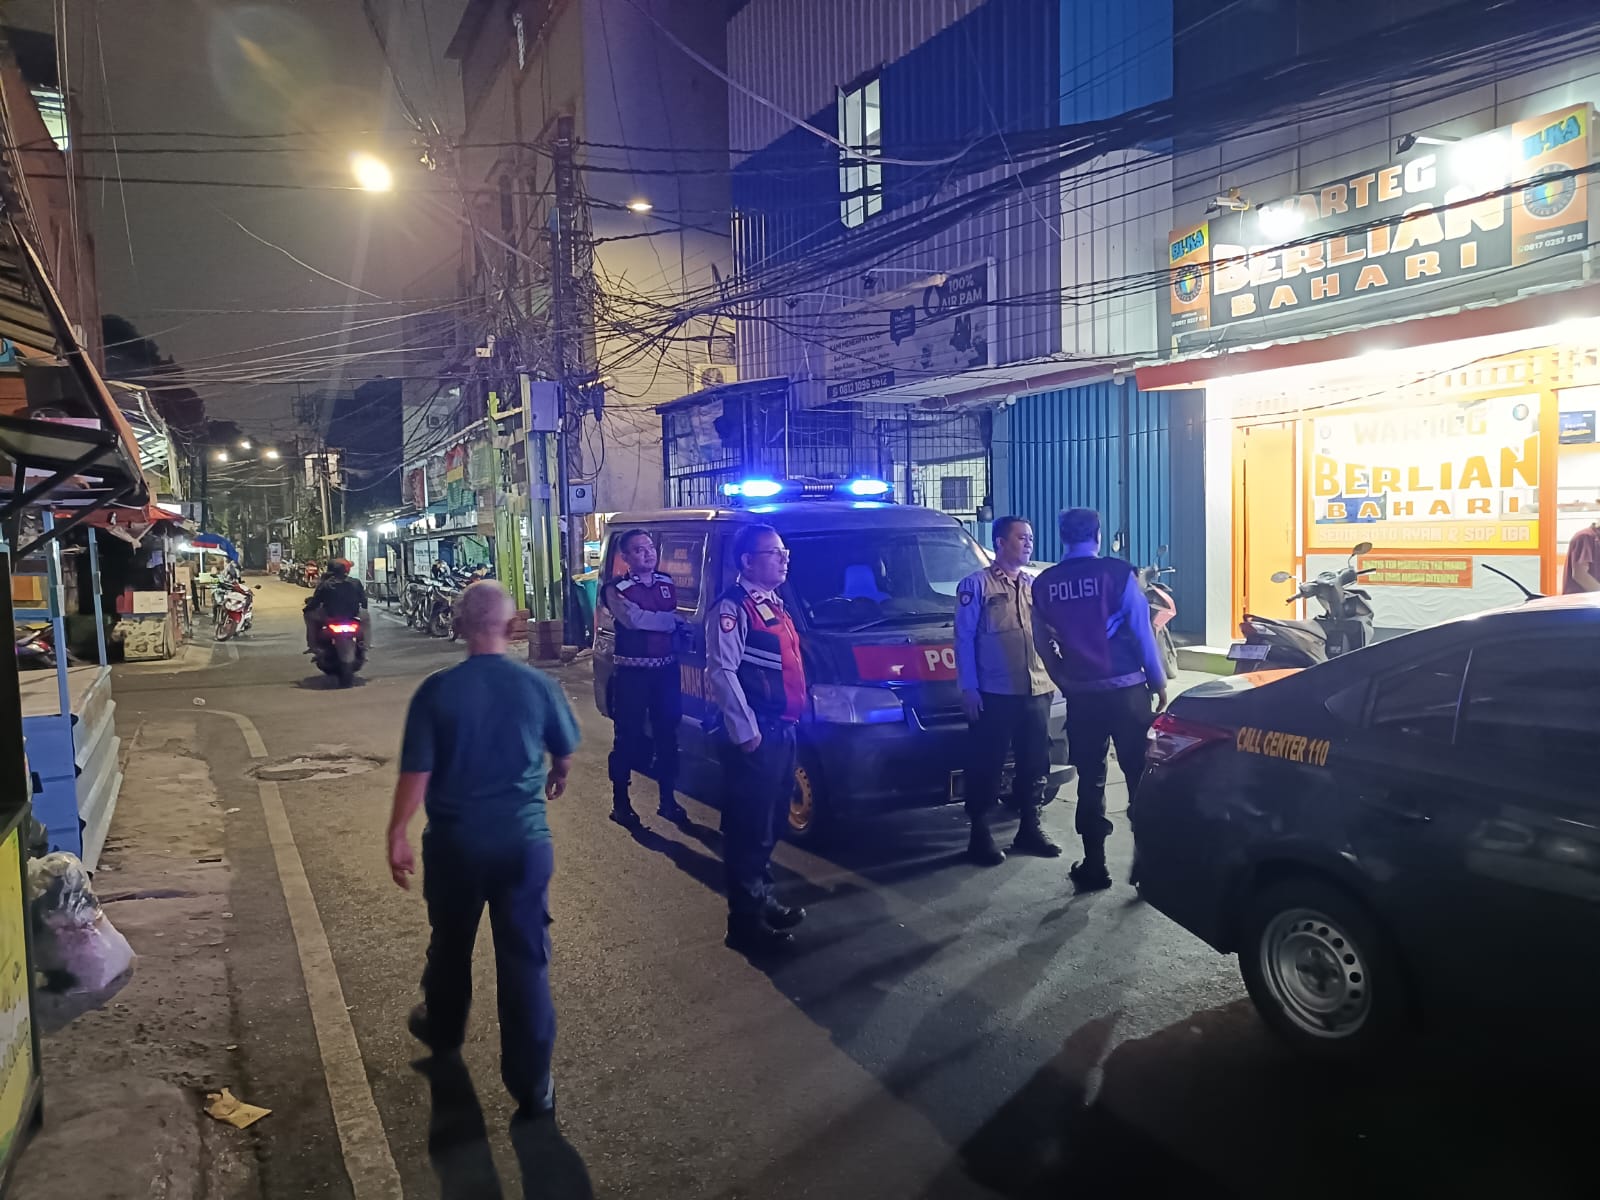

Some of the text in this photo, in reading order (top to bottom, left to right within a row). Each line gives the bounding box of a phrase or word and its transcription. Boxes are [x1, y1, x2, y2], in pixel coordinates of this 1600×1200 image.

[1270, 153, 1436, 224] ARTEG
[1213, 186, 1504, 295] BERLIAN
[949, 274, 975, 293] 100%
[1231, 242, 1478, 318] BAHARI
[942, 295, 958, 306] AIR
[1315, 434, 1540, 497] BERLIAN
[1326, 496, 1520, 519] BAHARI
[1464, 526, 1497, 541] SOP
[1049, 578, 1099, 602] POLISI
[924, 648, 957, 672] PO
[1237, 726, 1330, 767] CALL CENTER 110
